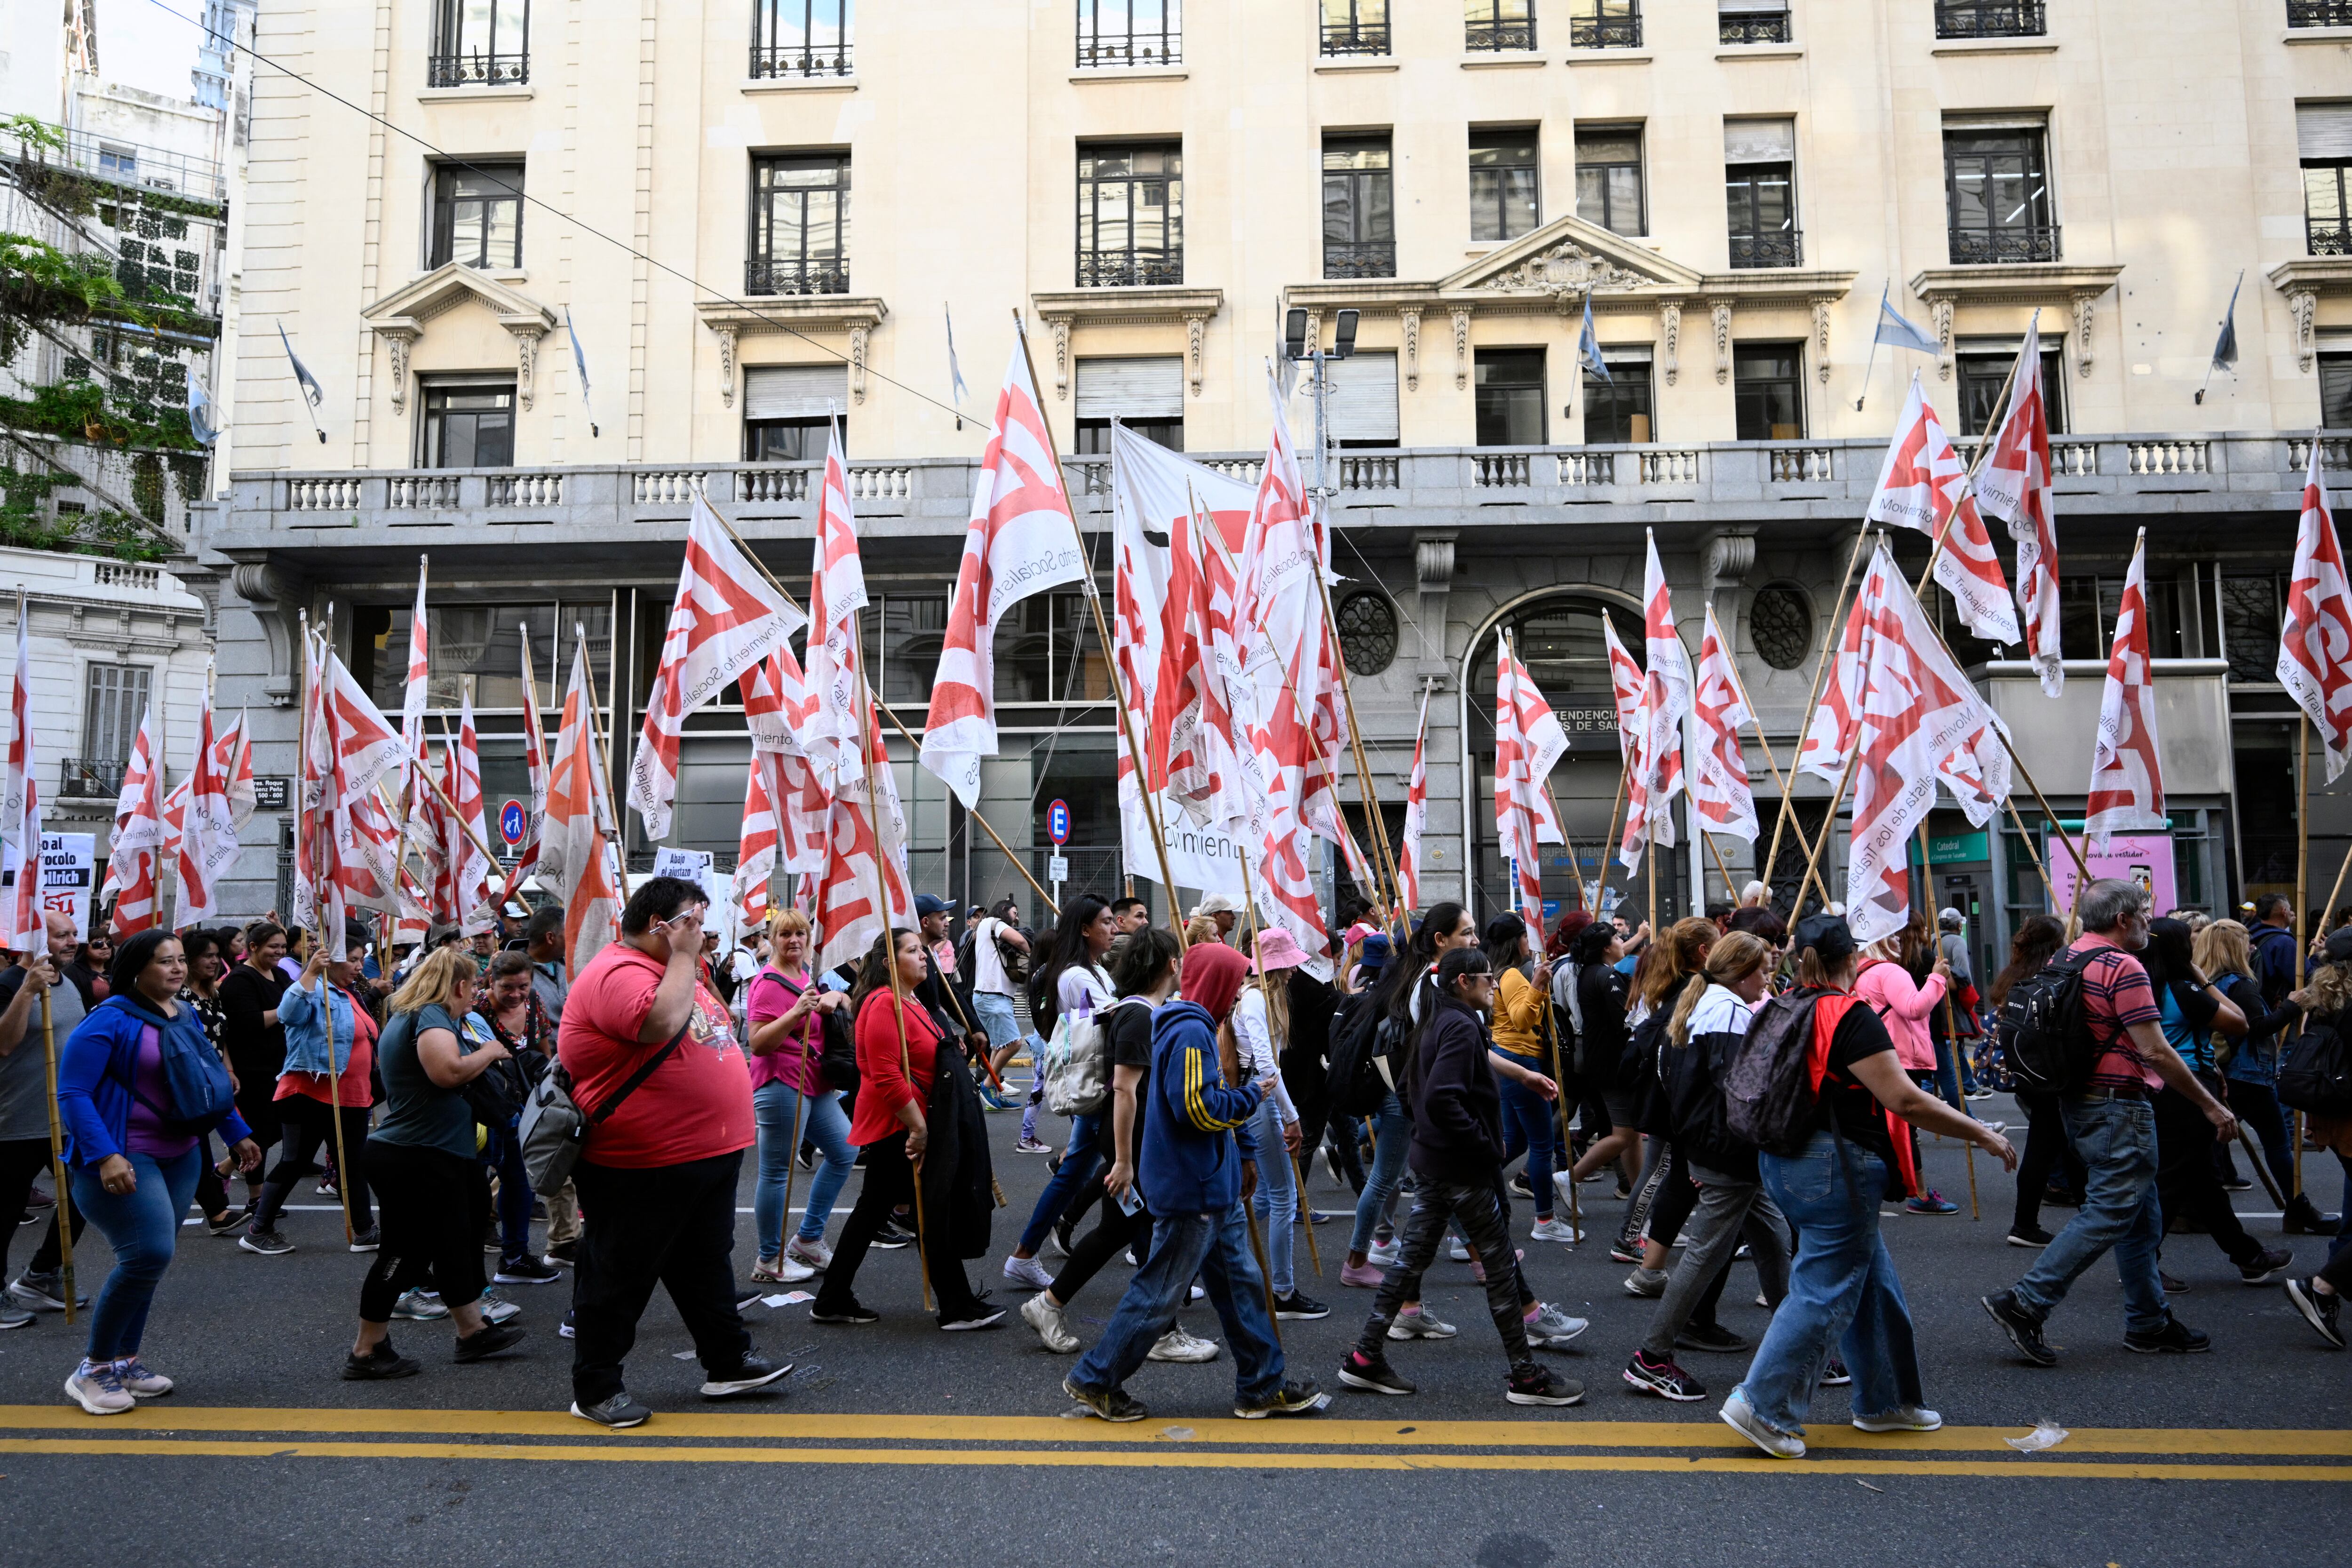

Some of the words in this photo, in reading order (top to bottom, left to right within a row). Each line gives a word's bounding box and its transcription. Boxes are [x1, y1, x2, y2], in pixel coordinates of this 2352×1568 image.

[1938, 560, 1954, 577] los
[1955, 576, 2015, 631] Trabajadores
[2279, 660, 2289, 675] de
[1577, 721, 1592, 731] DE
[1712, 765, 1722, 778] de
[1055, 808, 1065, 836] E
[424, 831, 433, 840] de
[1937, 840, 1959, 851] Catedral
[670, 853, 685, 865] Abajo
[661, 867, 667, 876] el
[668, 867, 691, 877] ajustazo
[1260, 891, 1269, 905] de
[1641, 1183, 1657, 1201] NOT
[1632, 1203, 1648, 1222] YOUR
